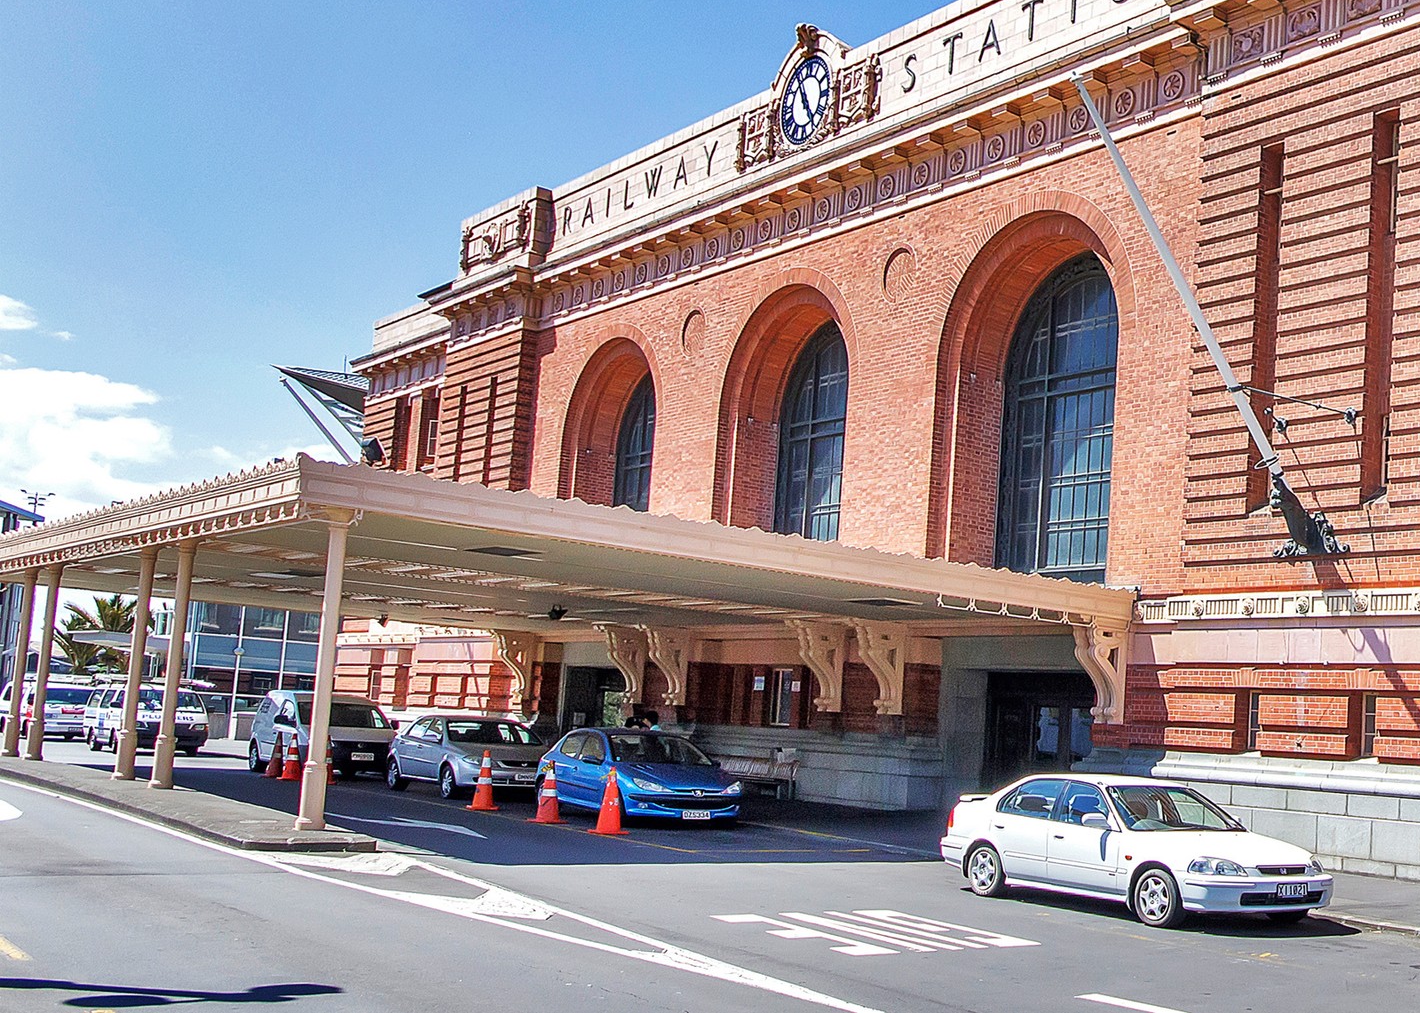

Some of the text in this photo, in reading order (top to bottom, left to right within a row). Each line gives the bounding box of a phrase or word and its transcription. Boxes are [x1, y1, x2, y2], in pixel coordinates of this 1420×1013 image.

[562, 140, 719, 237] RAILWAY
[142, 713, 195, 722] PLUERS
[709, 909, 1043, 956] GIVE
